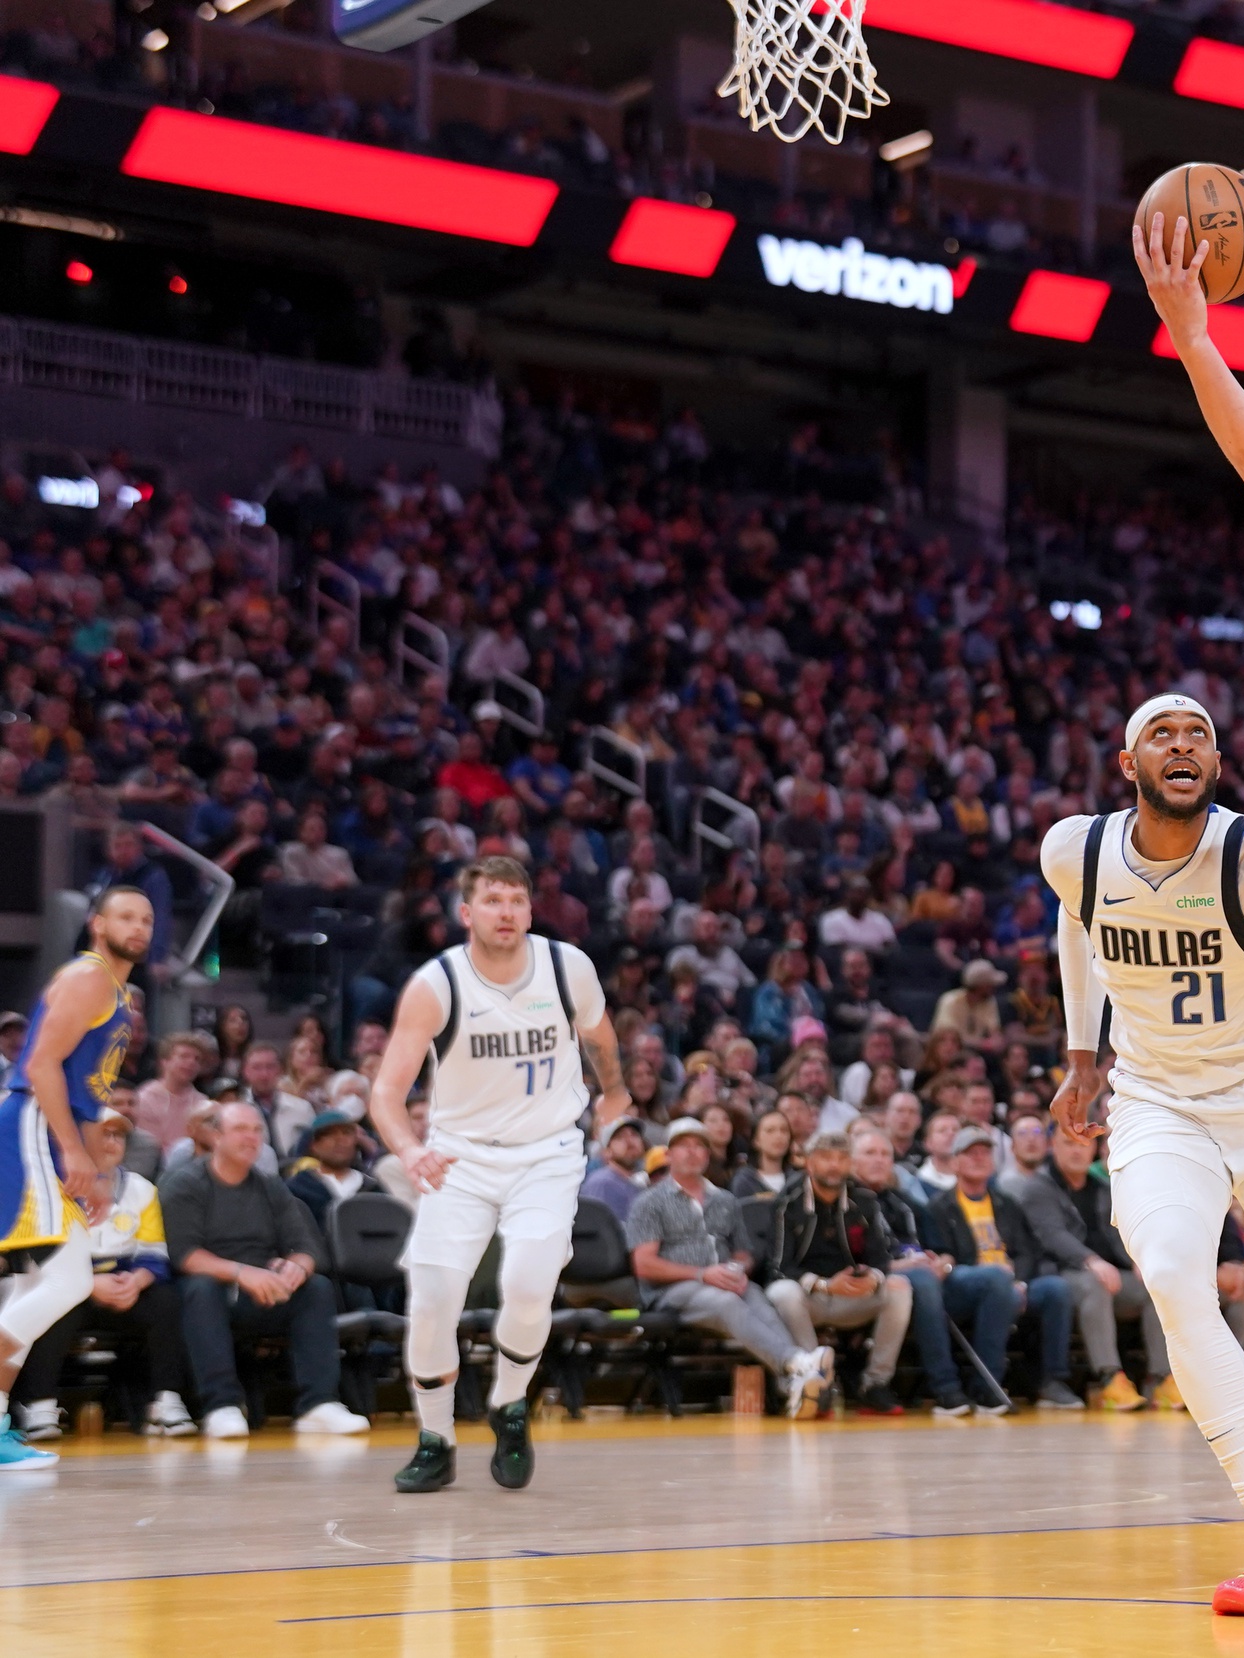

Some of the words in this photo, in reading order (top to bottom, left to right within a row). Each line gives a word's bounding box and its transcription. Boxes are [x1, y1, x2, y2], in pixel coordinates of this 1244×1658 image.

[757, 233, 953, 315] verizon
[1176, 895, 1215, 908] chime
[1100, 924, 1223, 967] DALLAS
[1171, 970, 1227, 1025] 21
[470, 1024, 558, 1059] DALLAS
[515, 1056, 556, 1096] 77
